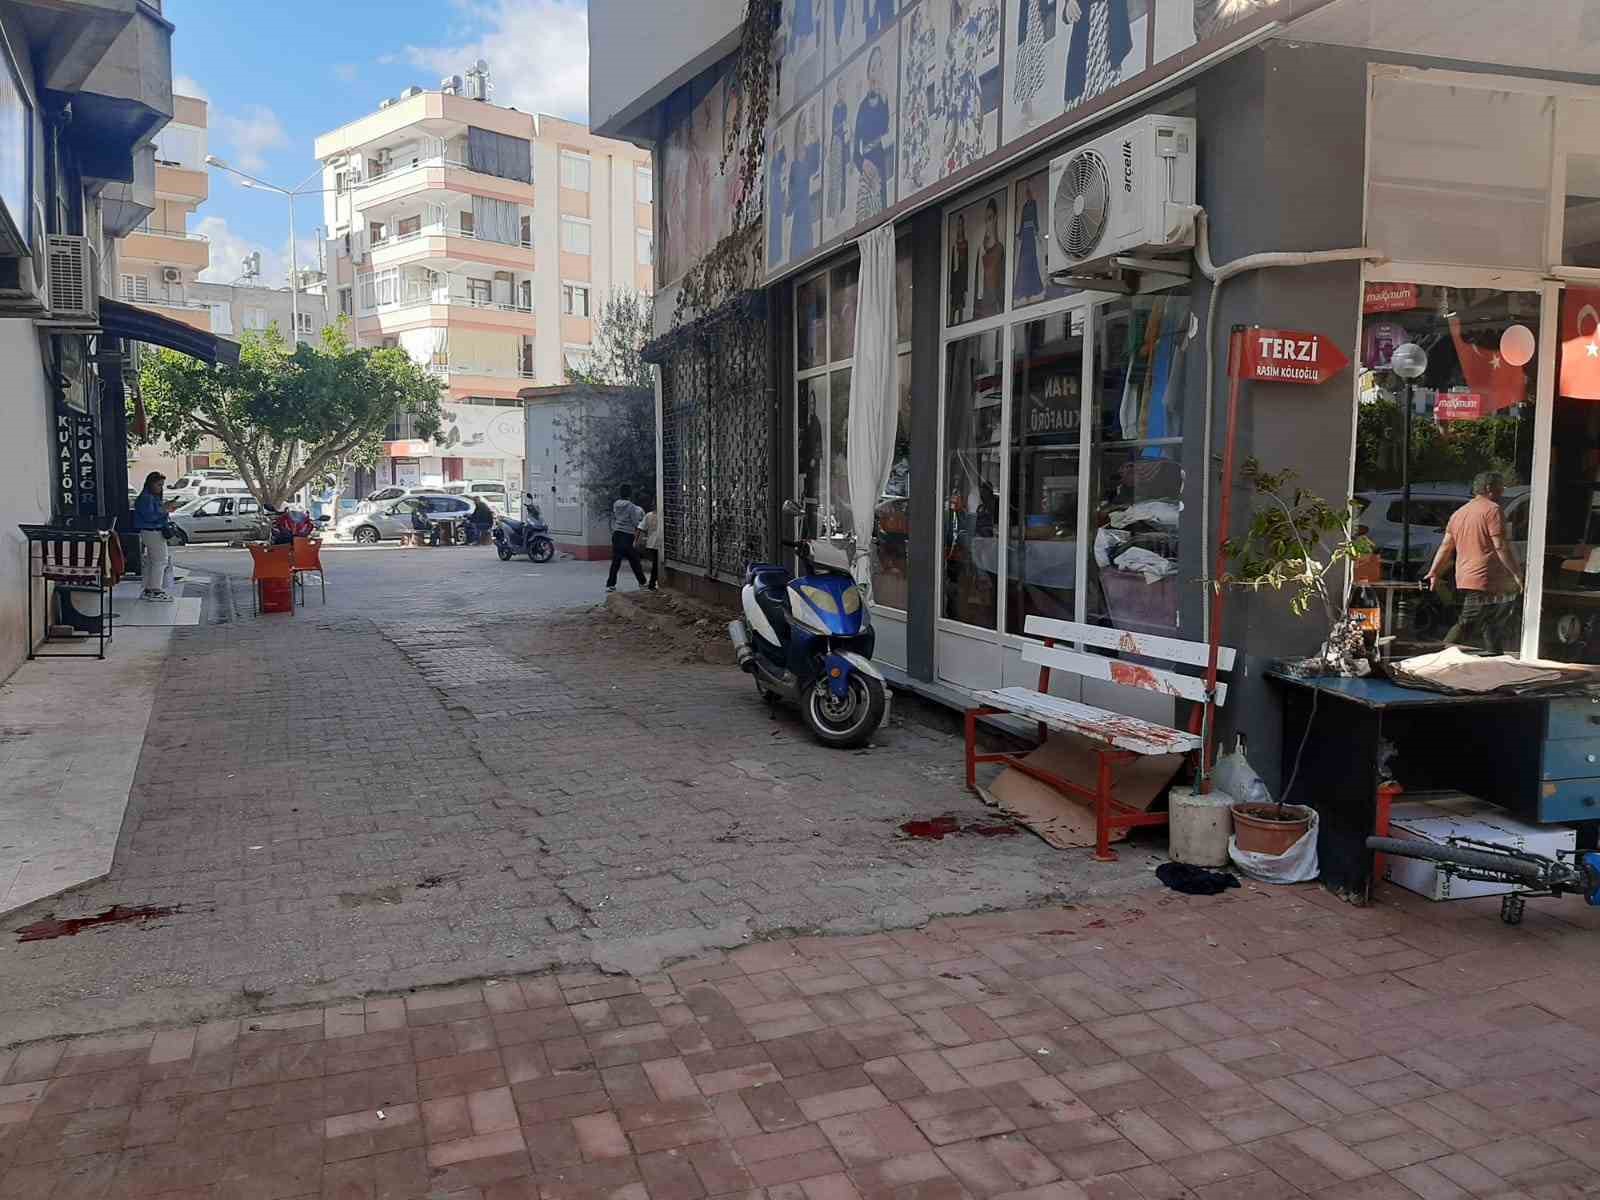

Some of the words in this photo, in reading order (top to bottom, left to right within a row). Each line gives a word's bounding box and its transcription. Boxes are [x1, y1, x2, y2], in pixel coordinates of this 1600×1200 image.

[1122, 140, 1133, 192] arçelik
[1258, 336, 1318, 362] TERZİ
[1256, 364, 1280, 377] RASİM
[58, 415, 73, 504] KUAFÖR
